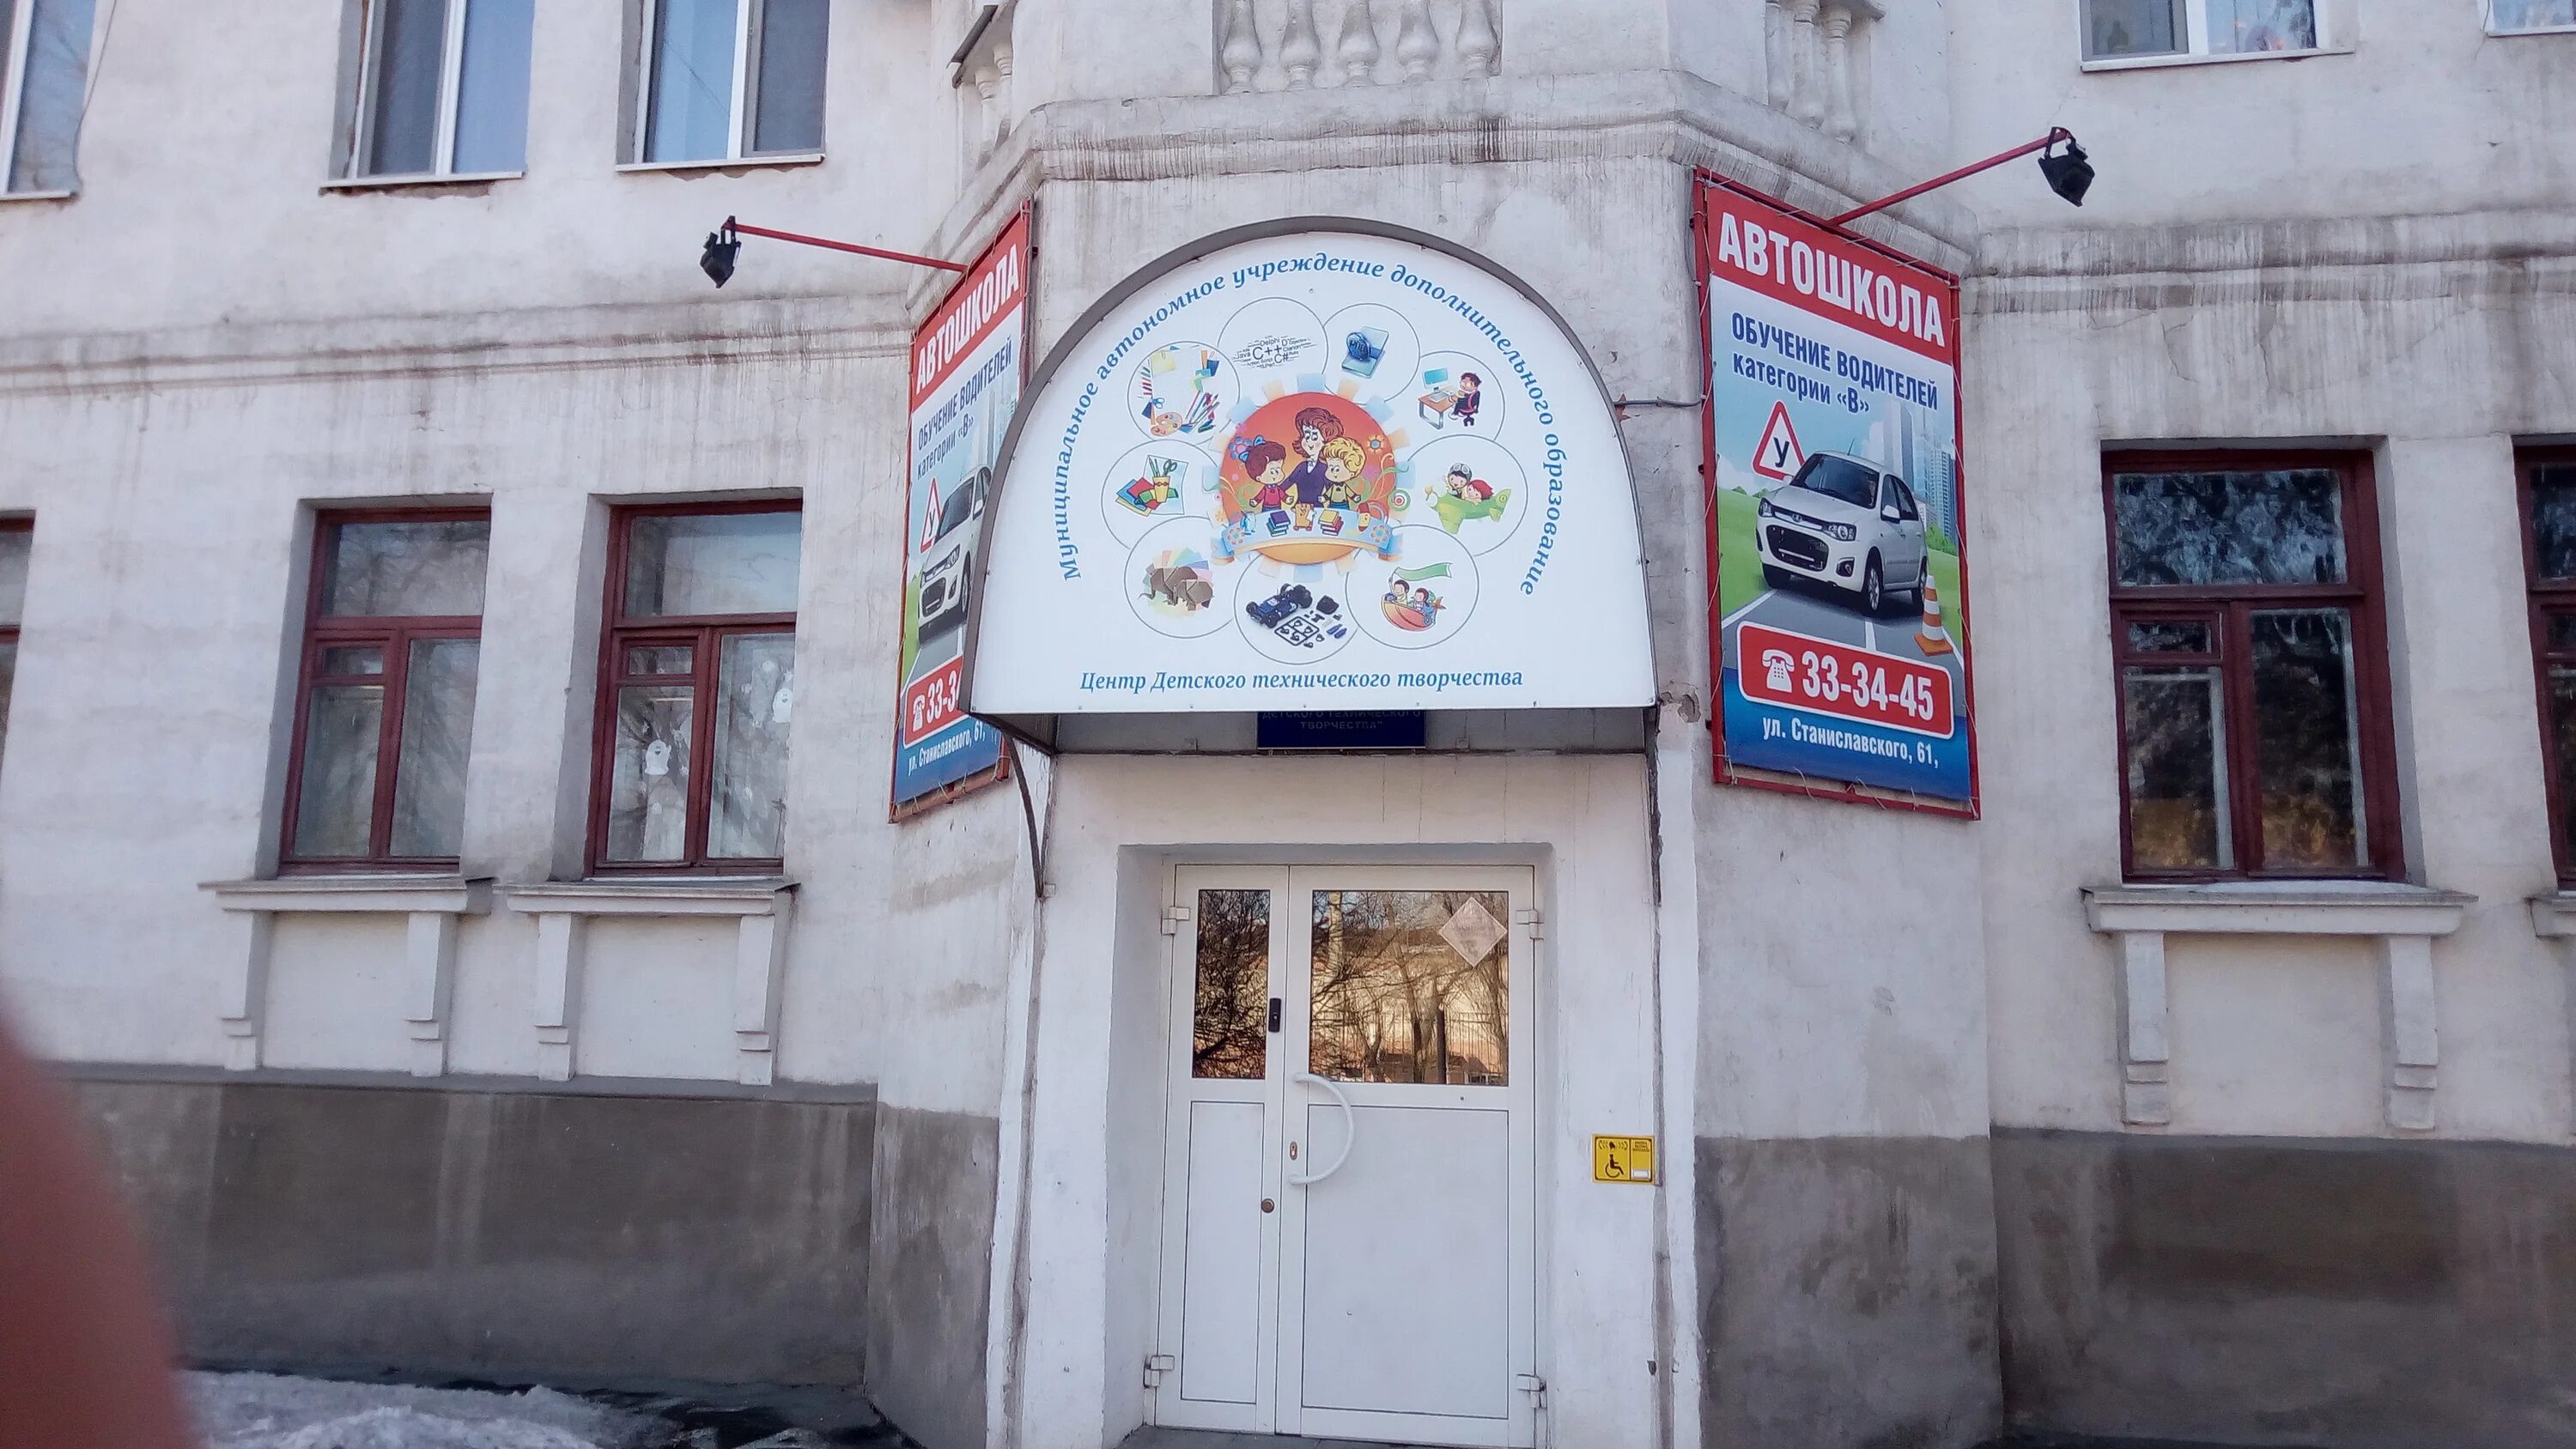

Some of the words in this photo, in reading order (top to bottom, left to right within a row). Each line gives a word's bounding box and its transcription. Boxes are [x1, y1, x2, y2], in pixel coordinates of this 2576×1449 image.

[1718, 212, 1946, 348] АВТОШКОЛА
[915, 244, 1019, 395] АВТОШКОЛА
[1253, 345, 1282, 360] C++
[1274, 353, 1288, 363] C#
[1731, 312, 1831, 373] ОБУЧЕНИЕ
[1837, 349, 1938, 411] ВОДИТЕЛЕЙ
[1733, 352, 1831, 405] категории
[918, 393, 957, 452] ОБУЧЕНИЕ
[959, 335, 1012, 412] ВОДИТЕЛЕЙ
[1052, 381, 1099, 582] Муниципальное
[1097, 274, 1225, 380] автономное
[1232, 252, 1385, 288] учреждение
[1390, 264, 1554, 426] дополнительного
[1520, 433, 1568, 597] образование
[917, 434, 957, 481] категории
[927, 669, 961, 724] 33-3
[1079, 672, 1146, 694] Центр
[1150, 671, 1246, 693] Детского
[1252, 672, 1391, 688] технического
[1397, 671, 1523, 692] творчества
[1801, 650, 1934, 722] 33-34-45
[908, 755, 918, 777] ул.
[919, 729, 972, 767] Станиславского,
[974, 720, 986, 742] 61,
[1762, 717, 1786, 741] ул.
[1791, 718, 1913, 765] Станиславского,
[1916, 742, 1940, 769] 61,
